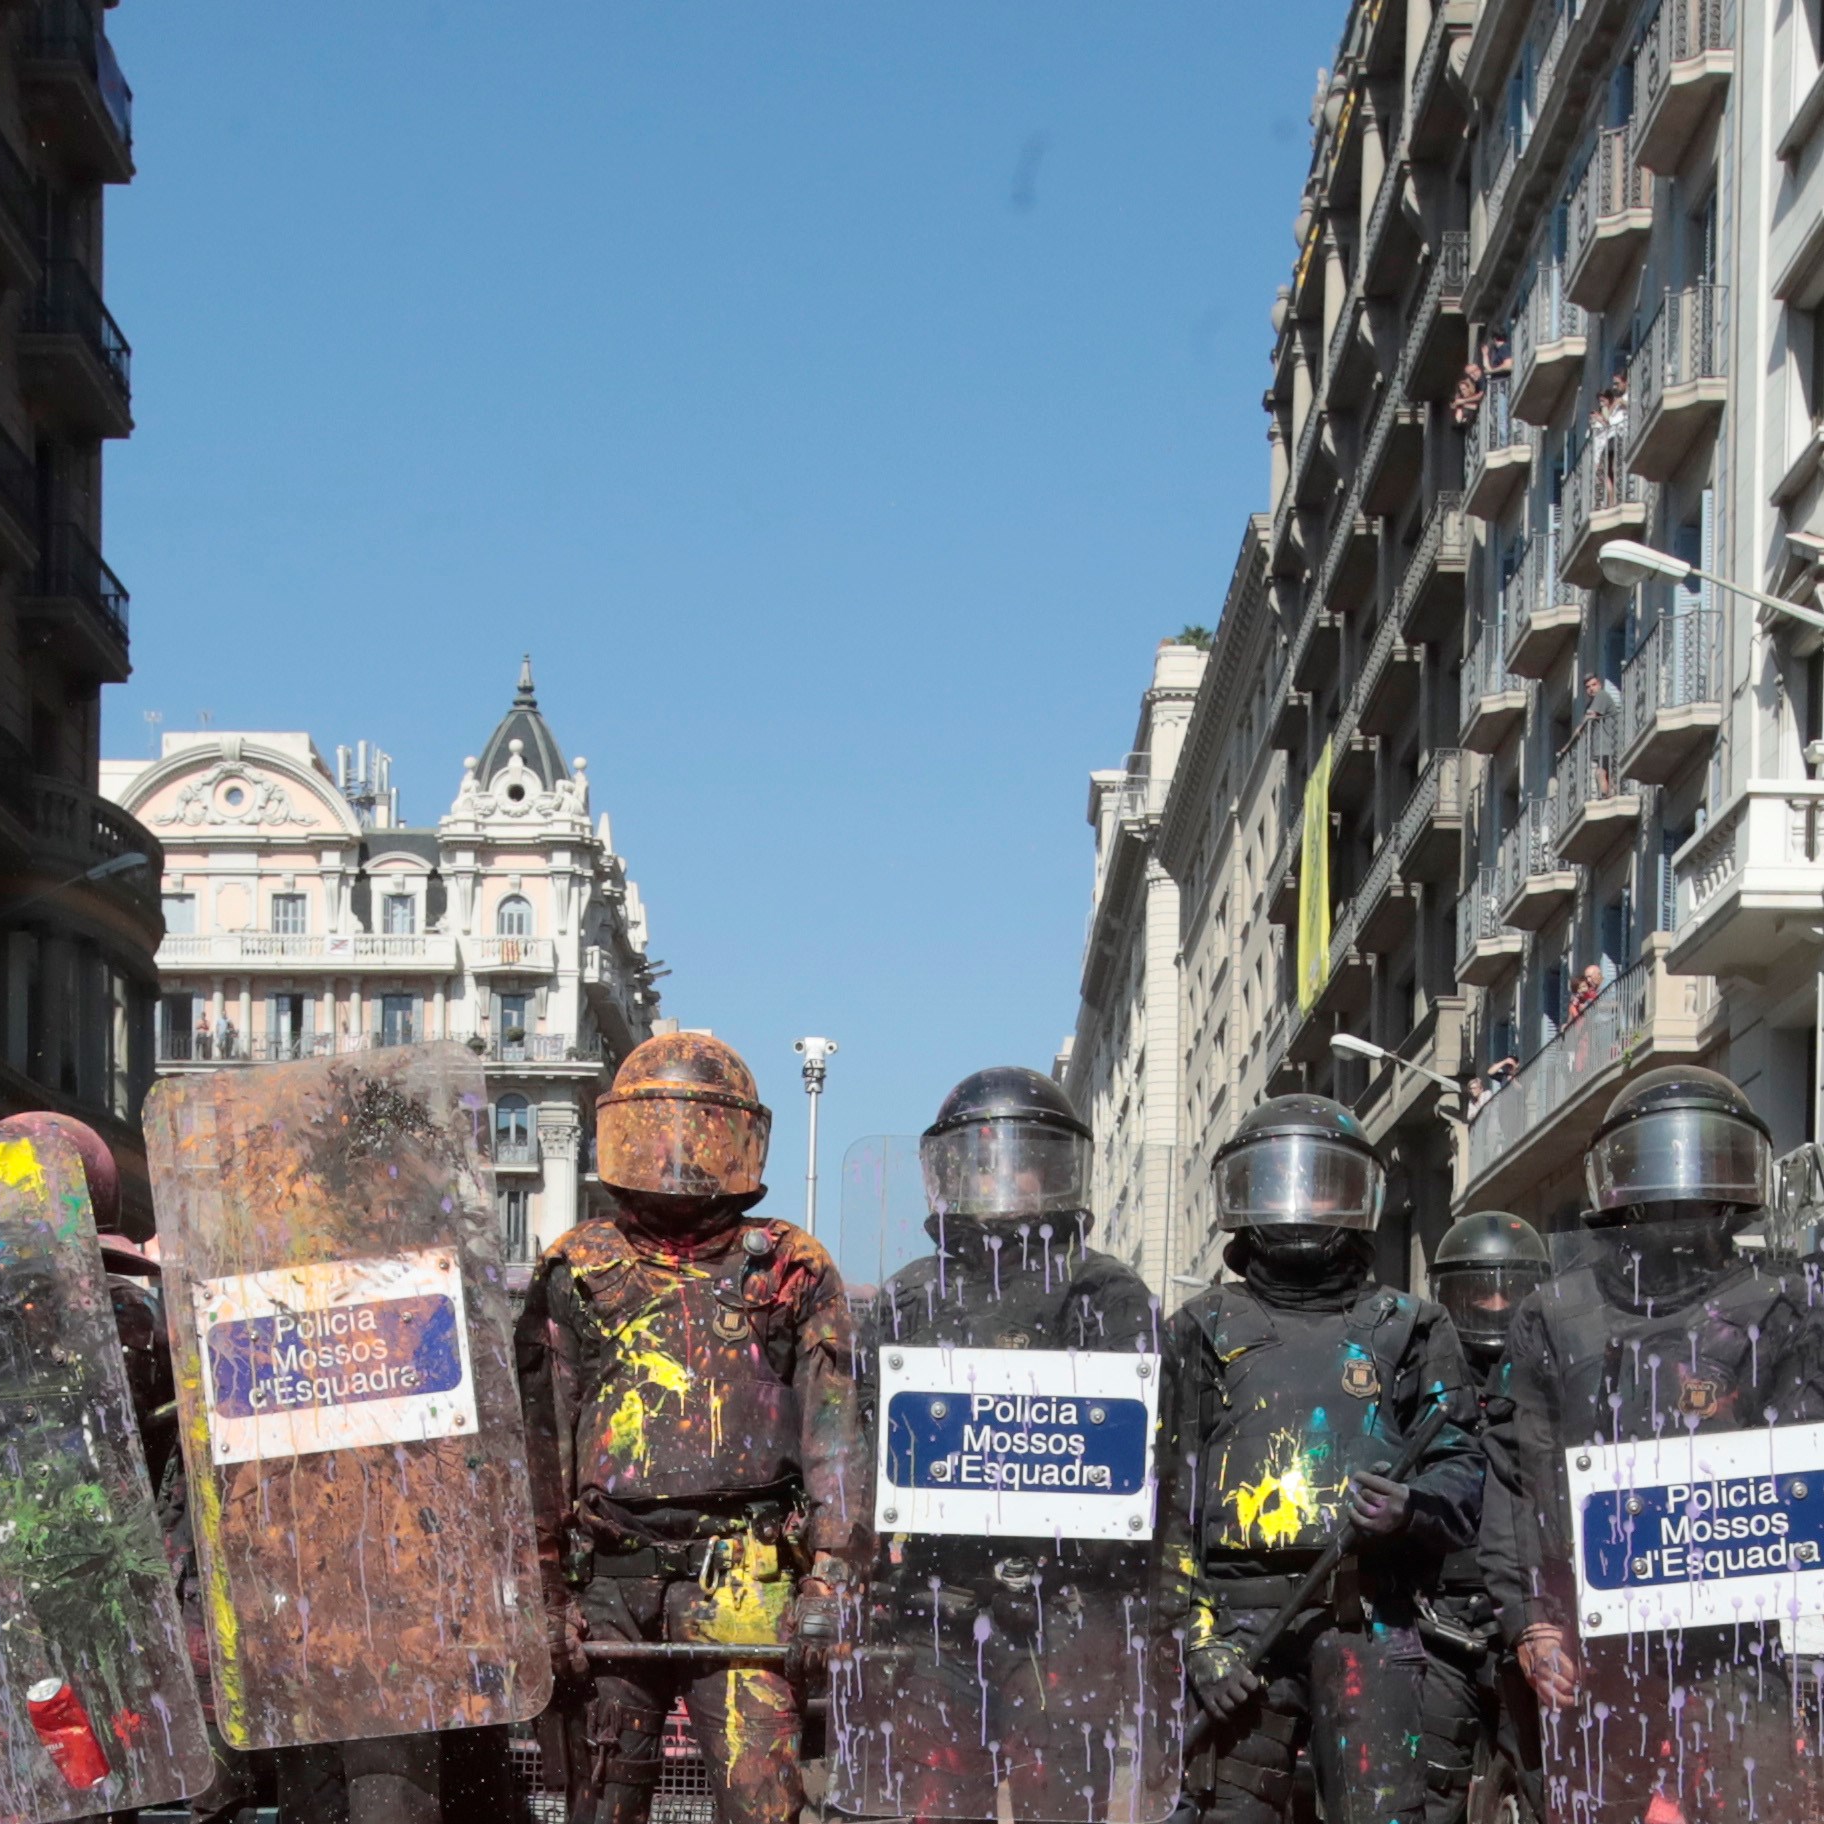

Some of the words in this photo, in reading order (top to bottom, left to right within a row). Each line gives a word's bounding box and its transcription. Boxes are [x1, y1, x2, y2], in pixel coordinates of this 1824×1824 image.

[274, 1306, 378, 1343] Policia
[270, 1337, 389, 1375] Mossos
[248, 1363, 421, 1409] d'Esquadra
[972, 1394, 1079, 1426] Policia
[962, 1424, 1086, 1456] Mossos
[1666, 1478, 1779, 1514] Policia
[1660, 1511, 1790, 1546] Mossos
